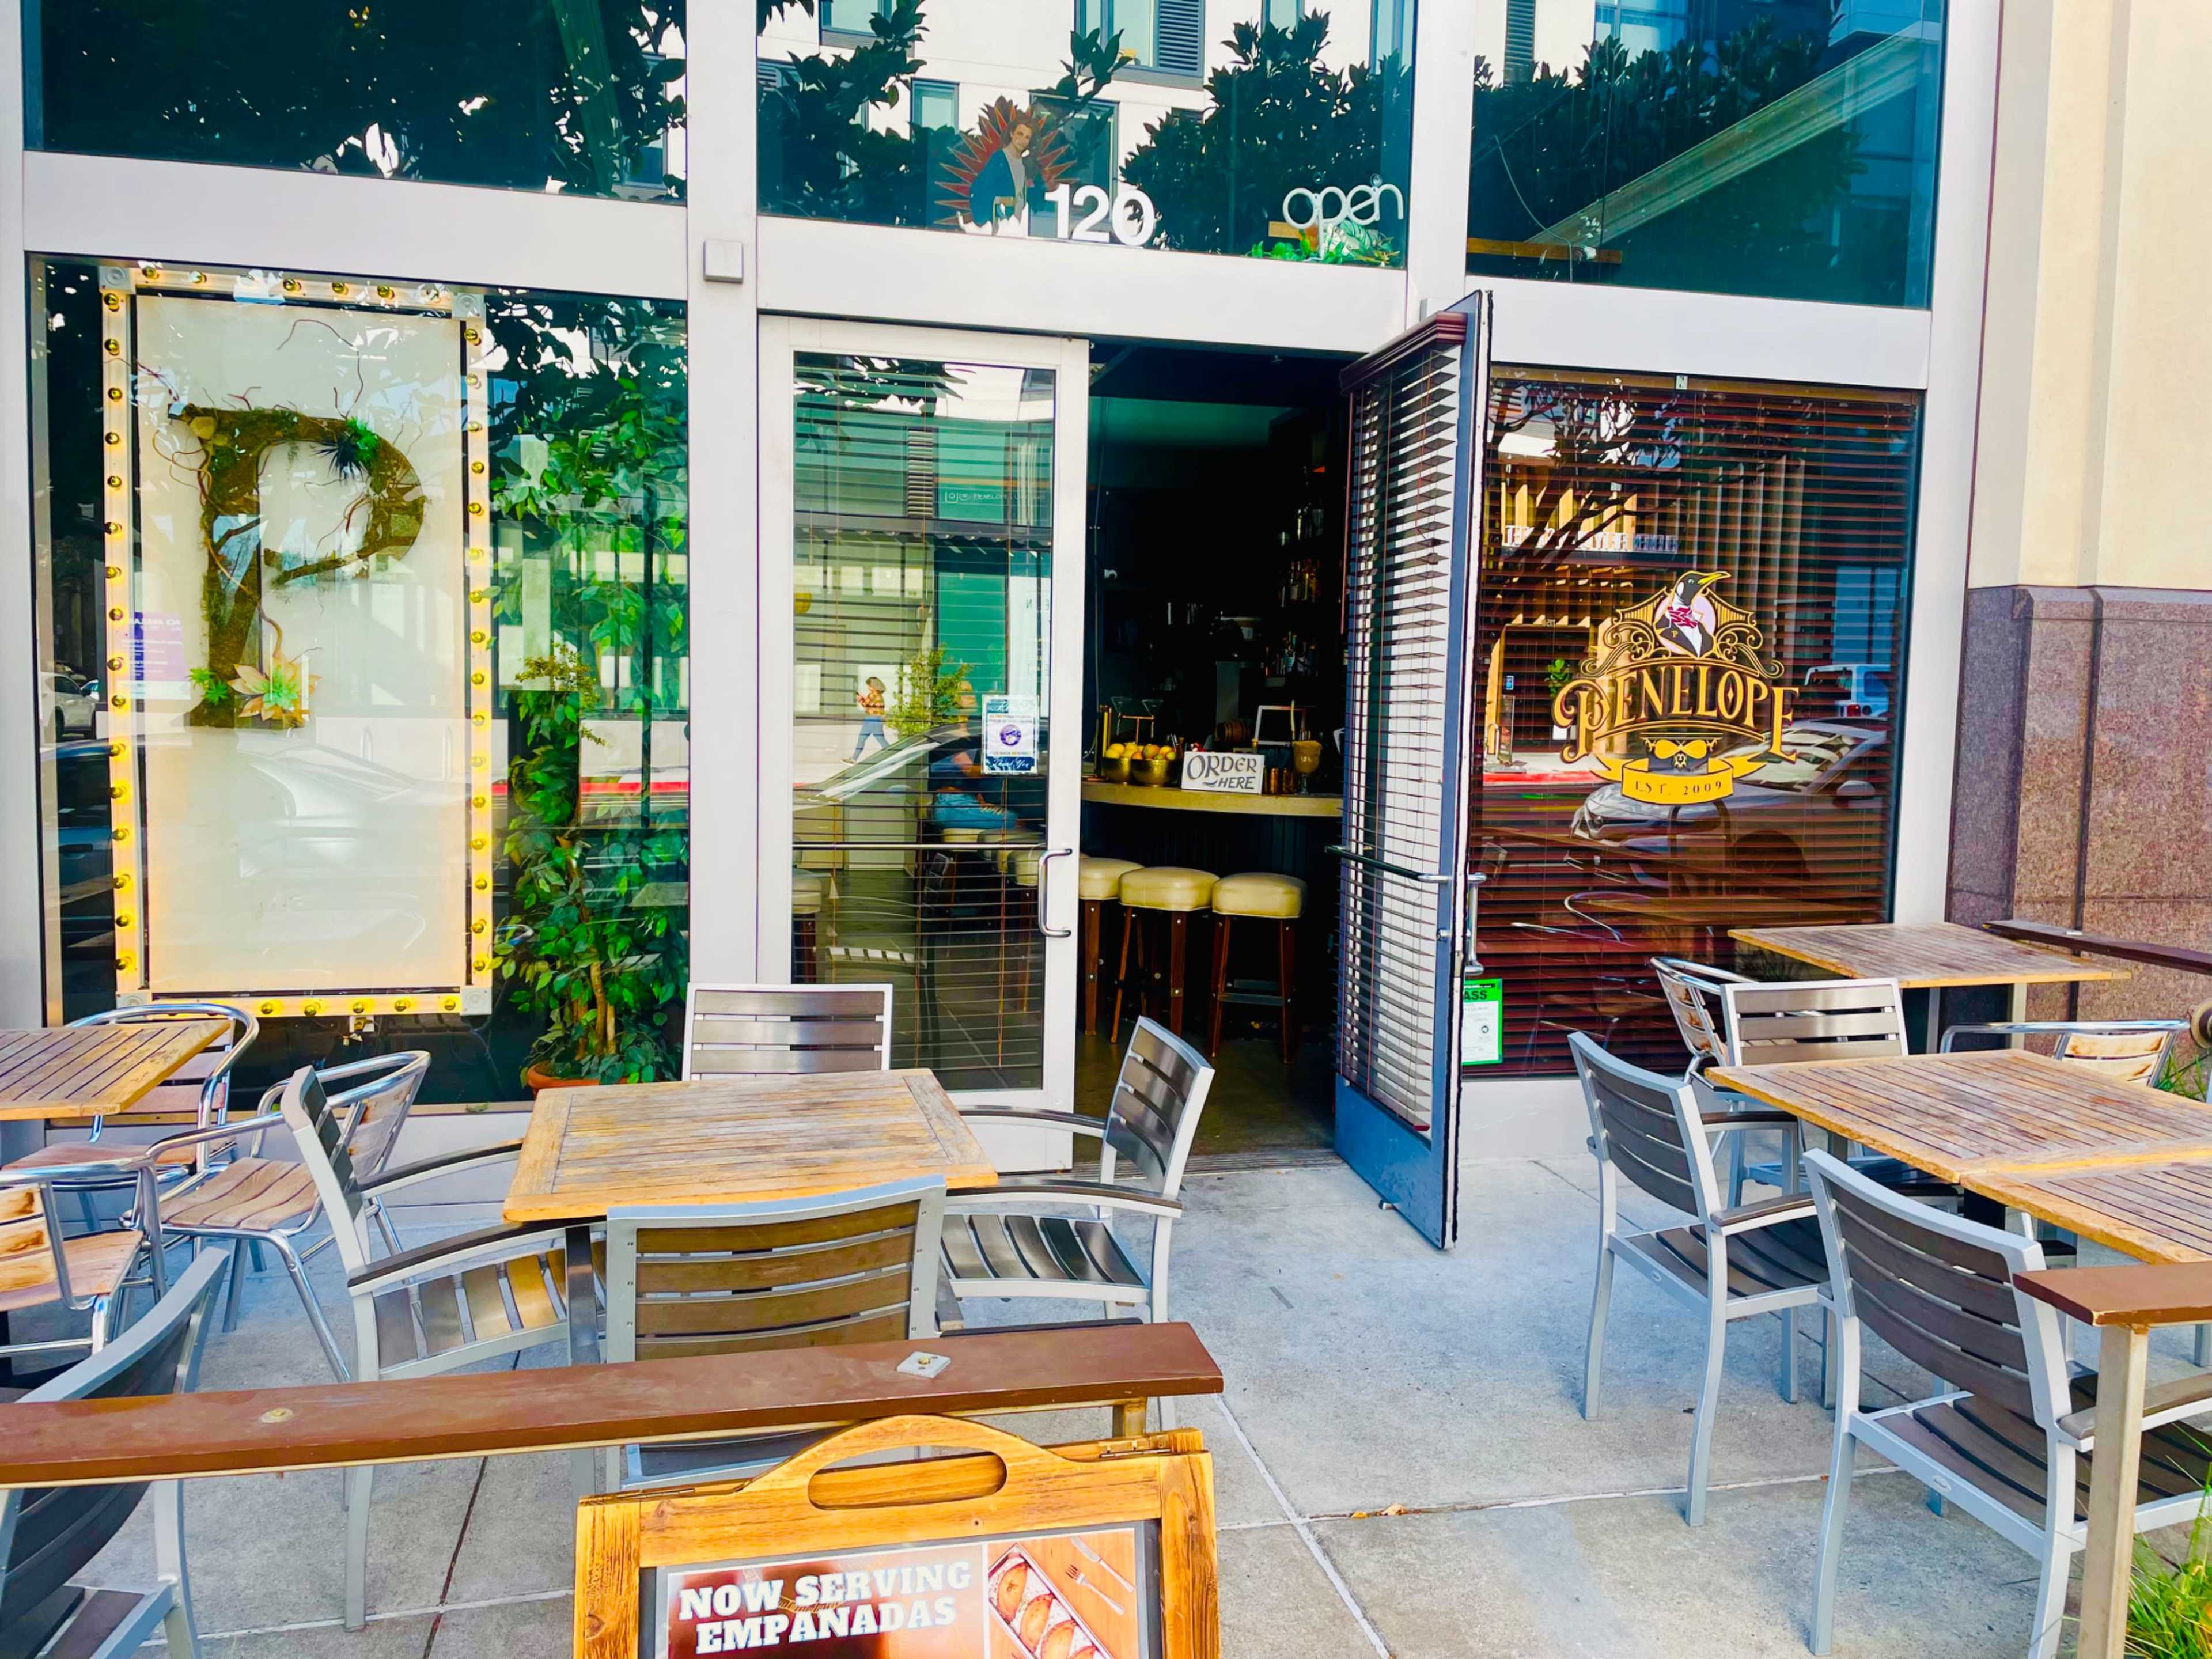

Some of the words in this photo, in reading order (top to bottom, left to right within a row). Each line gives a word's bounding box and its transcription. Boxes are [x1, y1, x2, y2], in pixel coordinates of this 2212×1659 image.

[1045, 184, 1155, 246] 120
[1283, 184, 1403, 260] open
[1552, 665, 1800, 764] PENELOPE
[1187, 755, 1257, 780] ORDER
[1218, 776, 1256, 790] HERE
[1684, 780, 1722, 796] 2009
[1465, 990, 1487, 1001] ASS
[679, 1578, 784, 1621] NOW
[794, 1560, 972, 1607] SERVING
[695, 1596, 956, 1655] EMPANADAS
